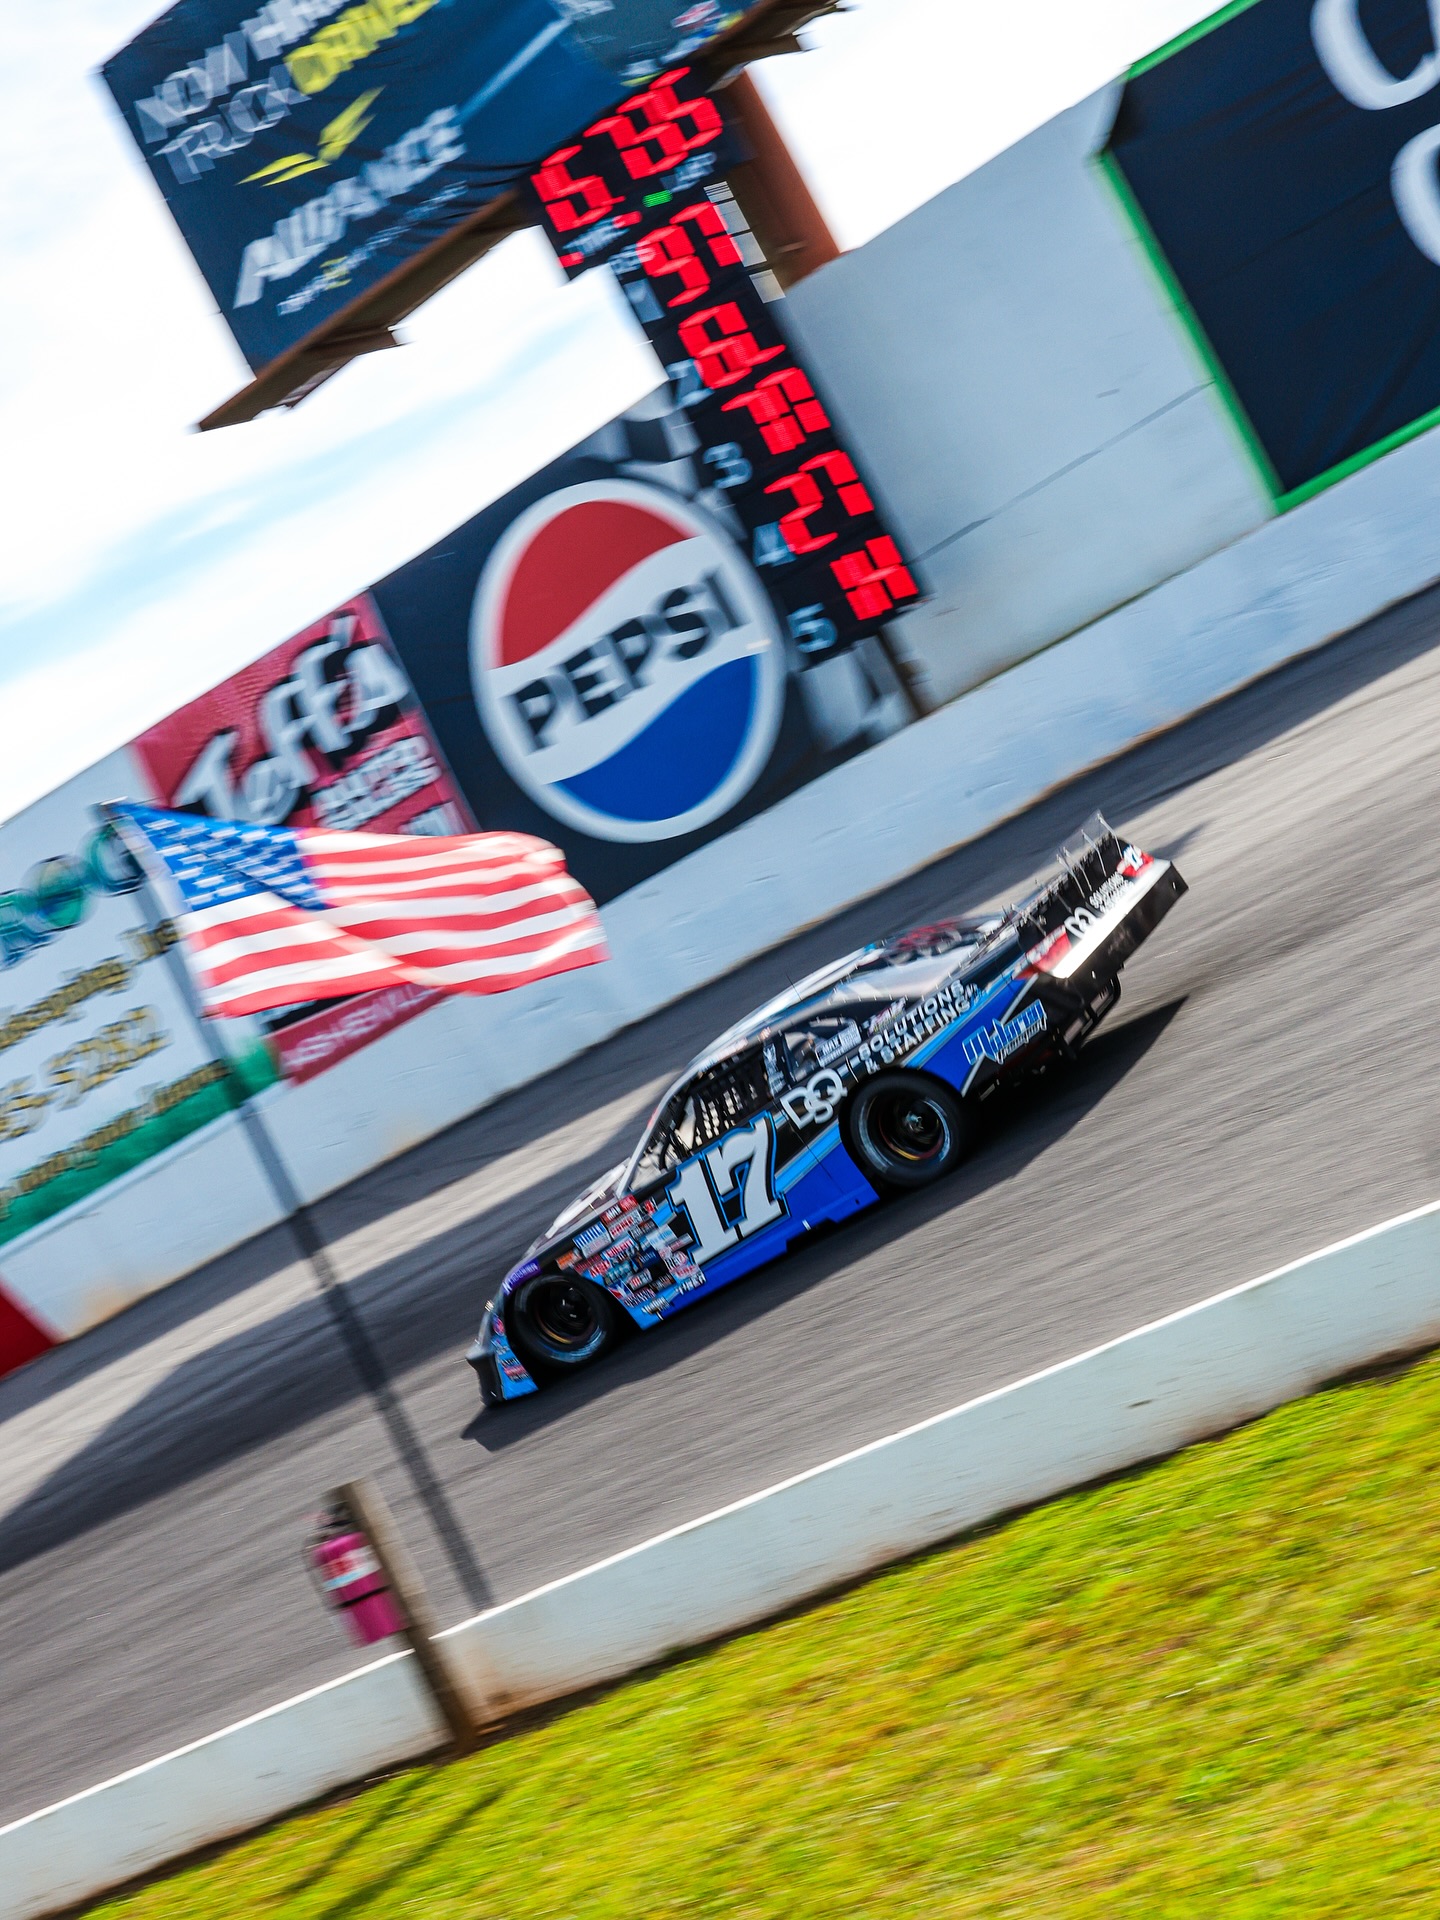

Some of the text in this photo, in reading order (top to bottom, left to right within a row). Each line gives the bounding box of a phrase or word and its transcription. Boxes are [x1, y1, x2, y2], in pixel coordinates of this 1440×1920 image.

[703, 441, 753, 490] 3
[501, 564, 752, 757] PEPSI
[788, 603, 839, 655] 5
[858, 980, 966, 1062] SOLUTIONS
[880, 1000, 971, 1067] STAFFING
[665, 1112, 788, 1266] 17
